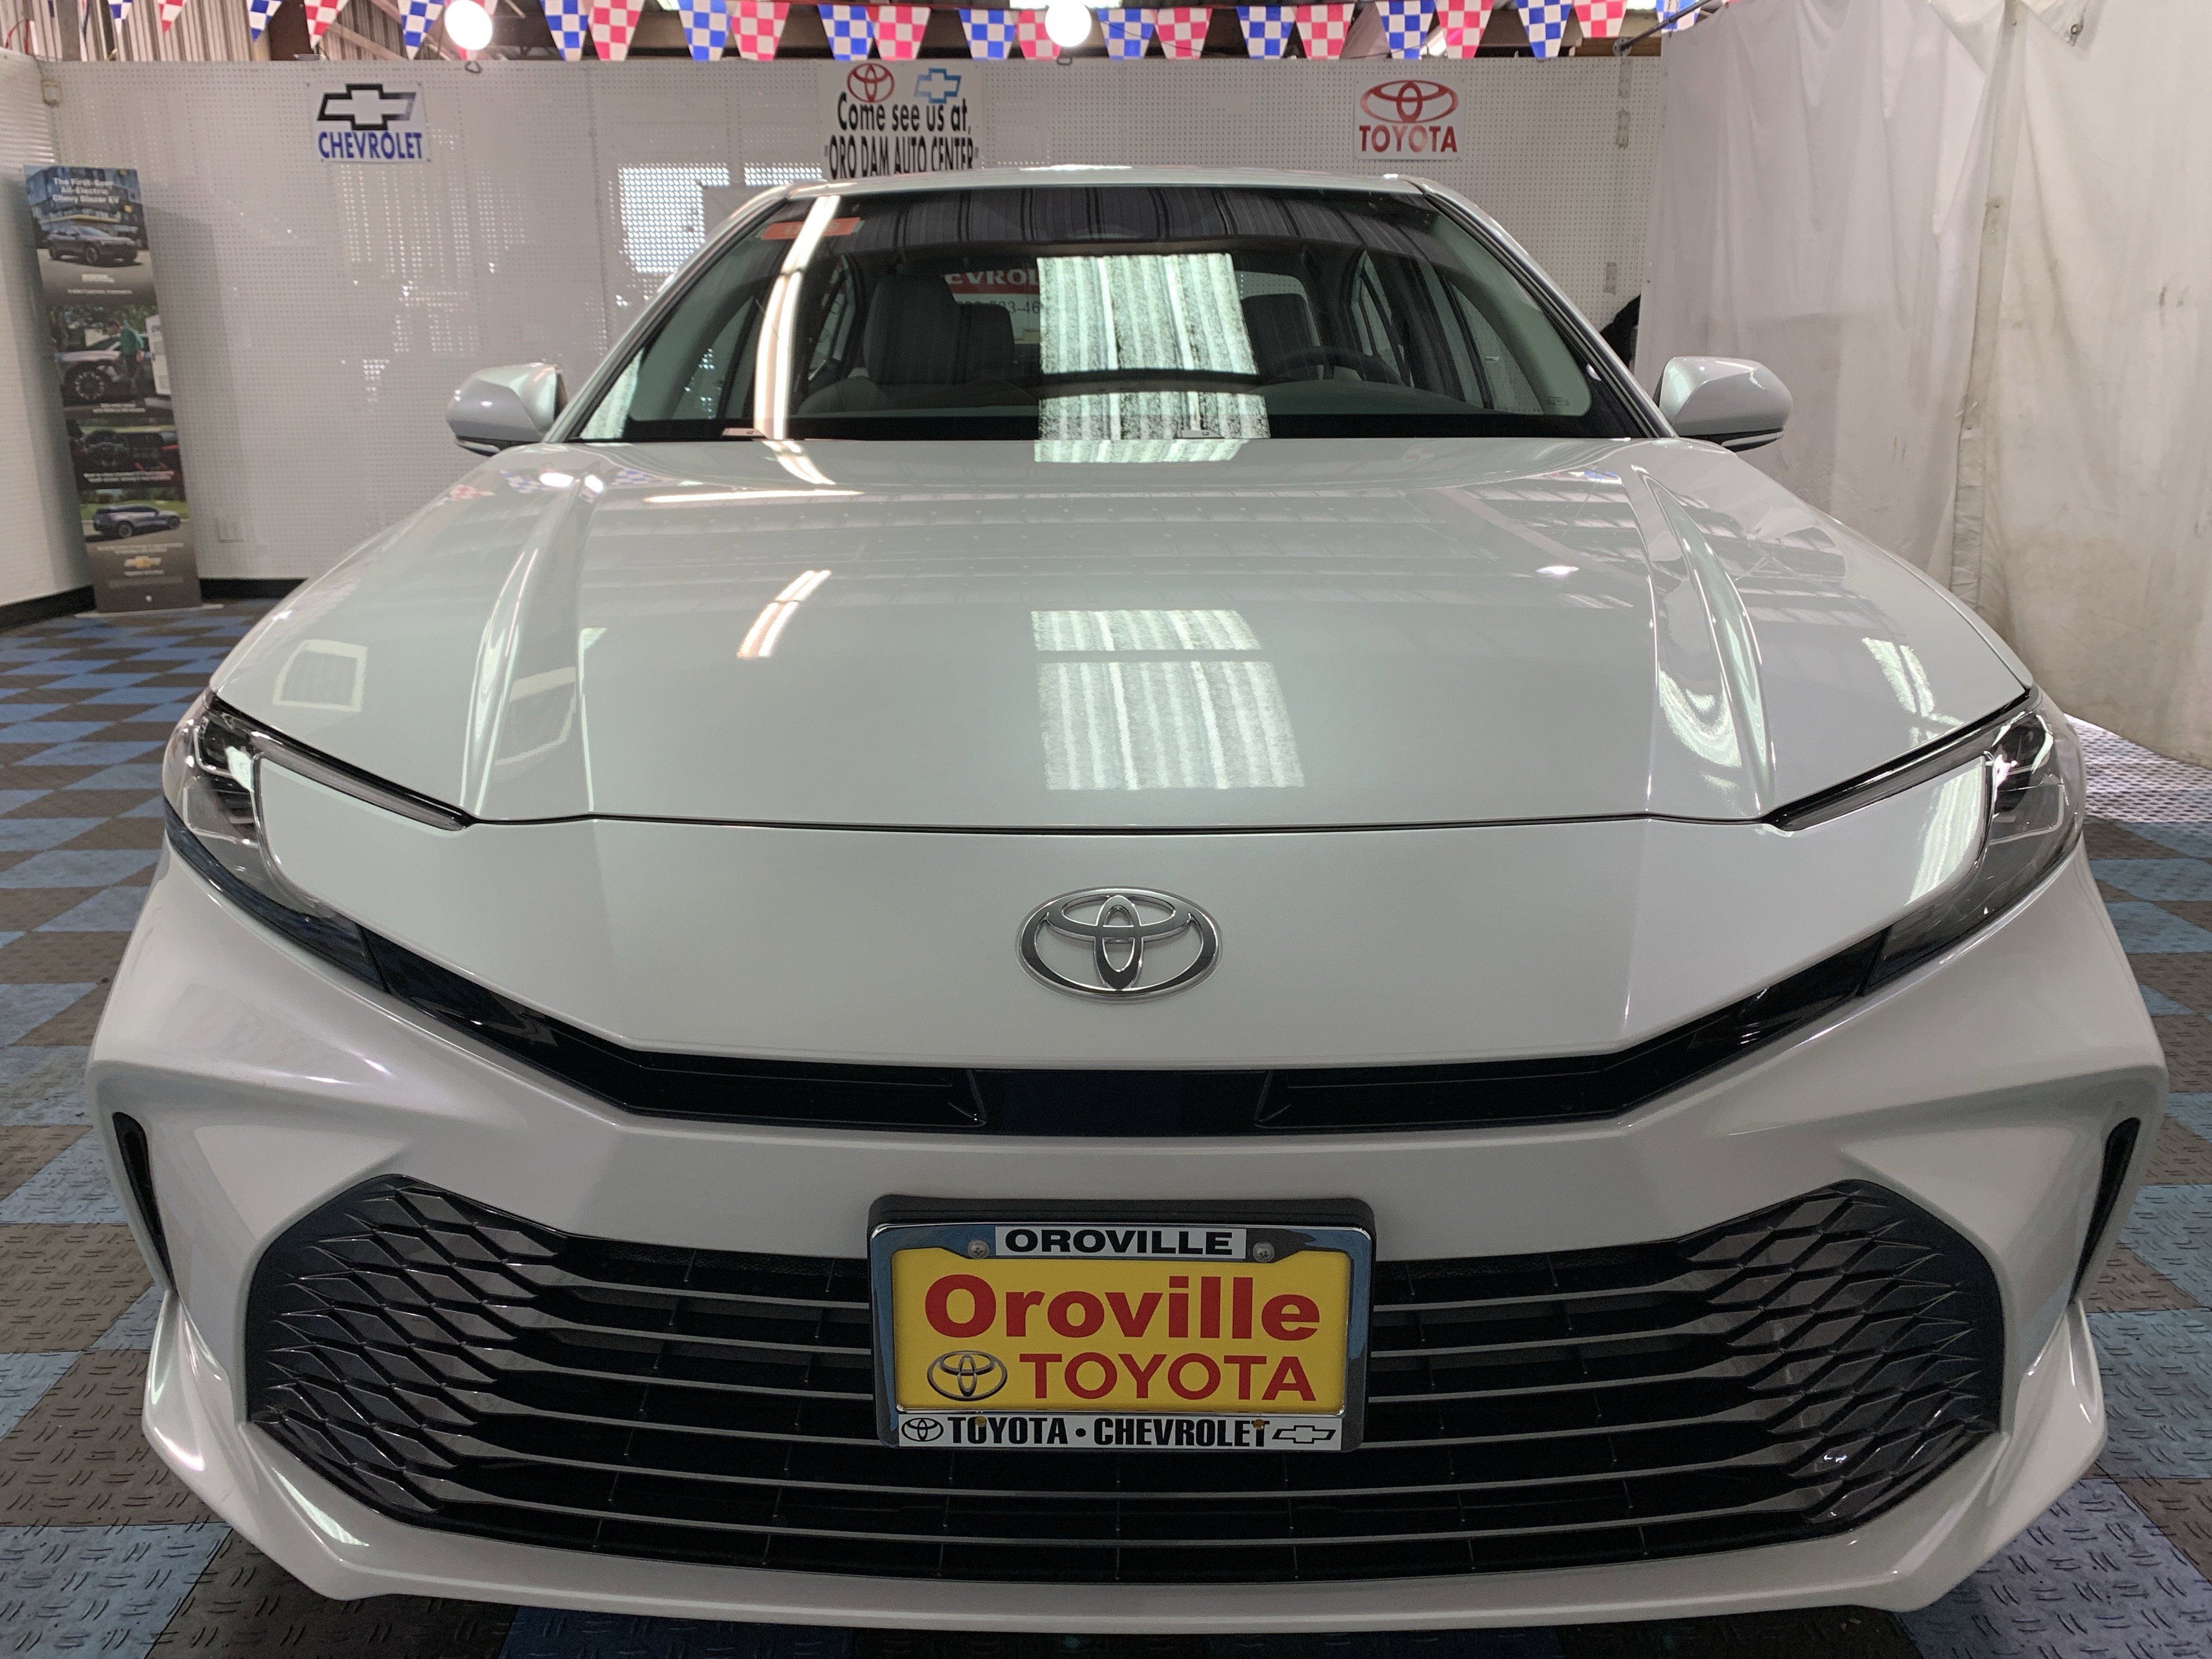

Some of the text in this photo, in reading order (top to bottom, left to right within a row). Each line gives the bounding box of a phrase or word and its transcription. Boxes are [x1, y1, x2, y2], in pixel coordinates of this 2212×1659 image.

[837, 91, 886, 131] Come
[892, 104, 920, 131] see
[927, 105, 944, 132] us
[318, 131, 422, 159] CHEVROLET
[861, 136, 890, 178] DAM
[894, 136, 927, 174] AUTO
[1359, 125, 1458, 153] TOYOTA
[1005, 1228, 1233, 1256] OROVILLE
[924, 1274, 1320, 1341] Oroville
[1019, 1352, 1317, 1401] TOYOTA
[947, 1416, 1270, 1447] TOYOTA CHEVROLET
